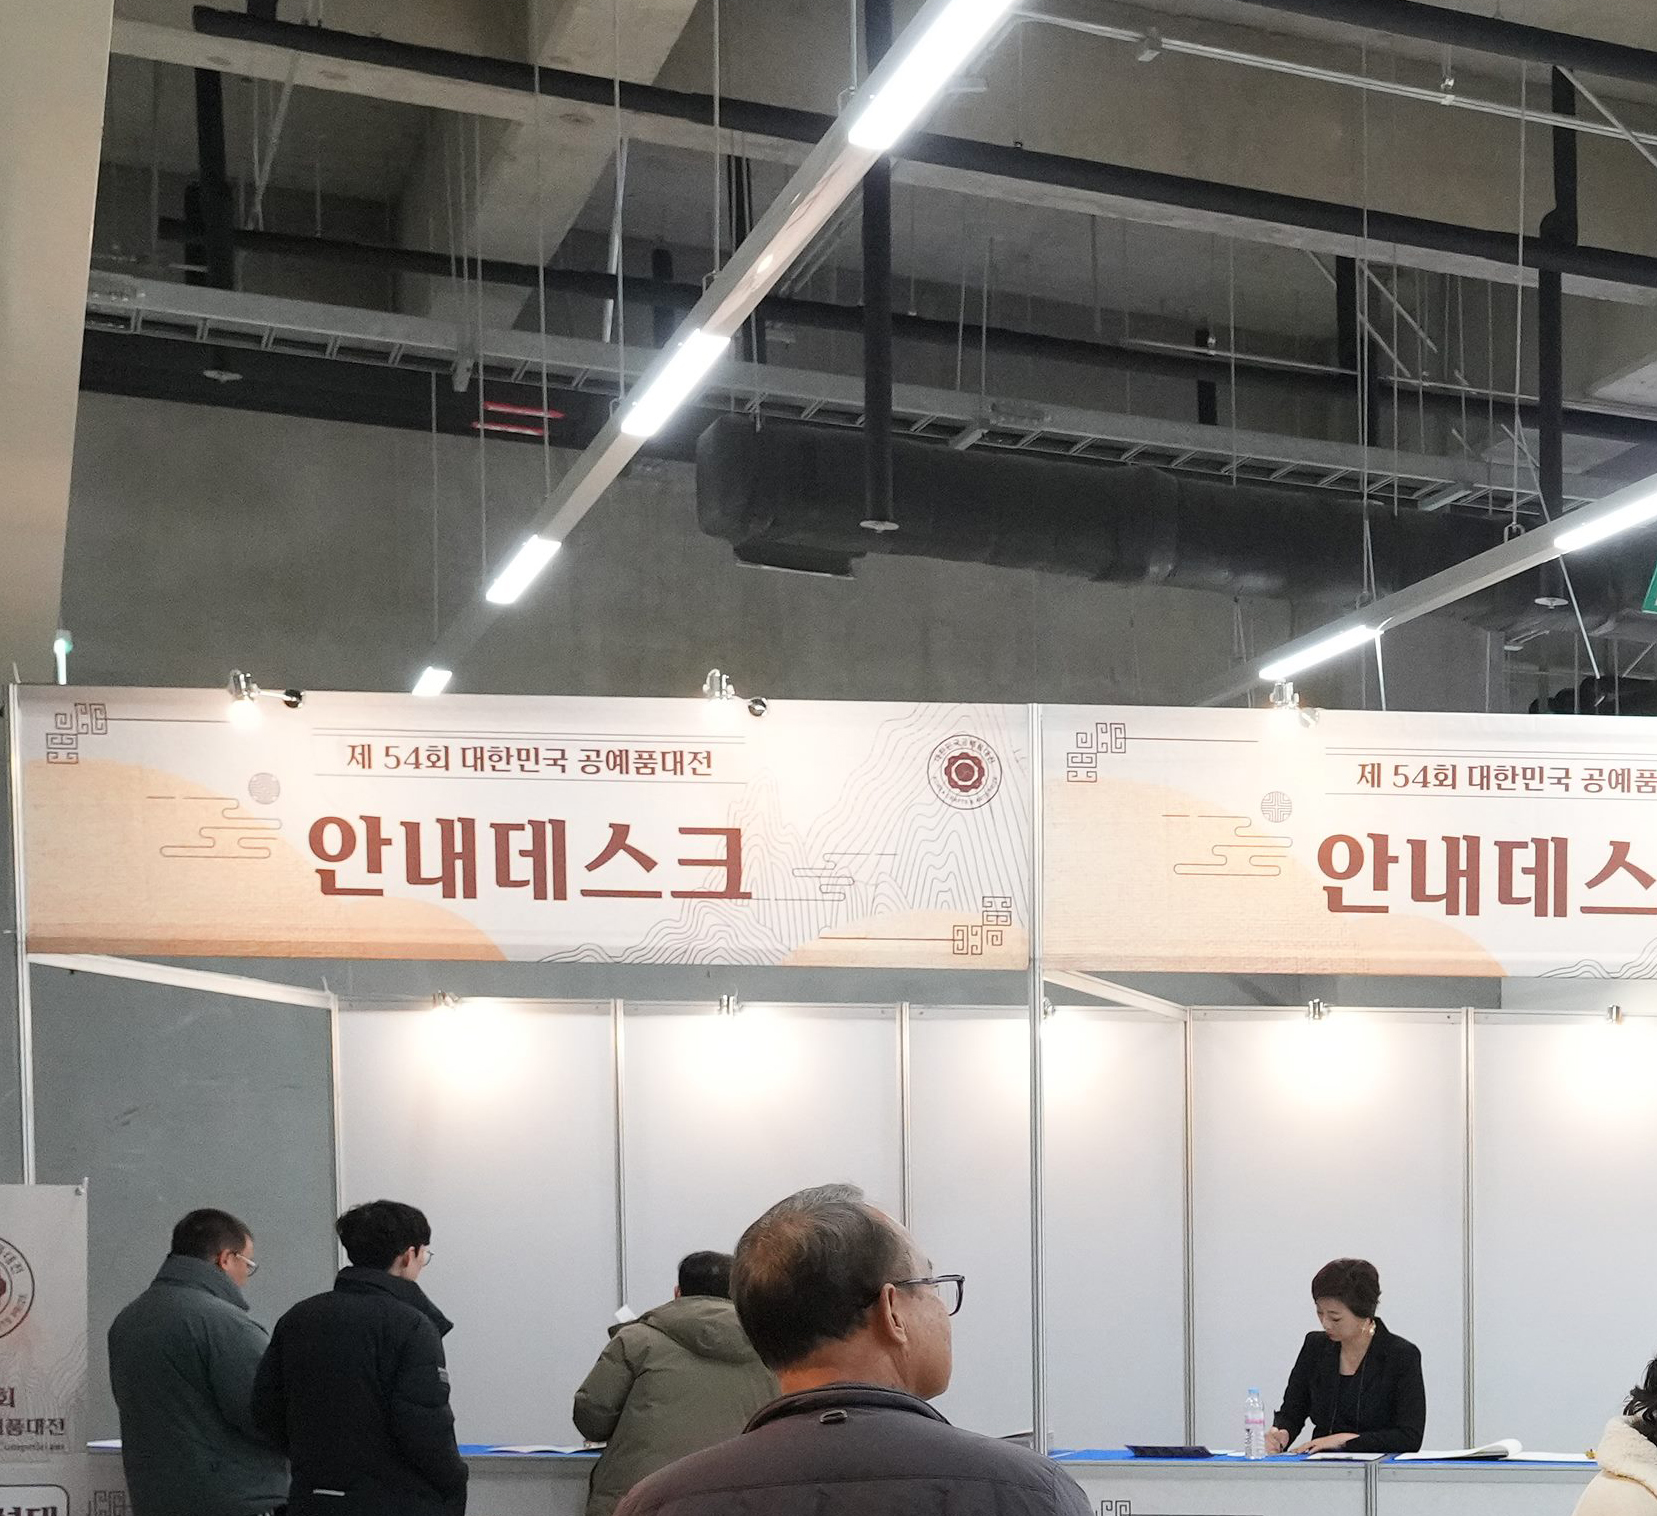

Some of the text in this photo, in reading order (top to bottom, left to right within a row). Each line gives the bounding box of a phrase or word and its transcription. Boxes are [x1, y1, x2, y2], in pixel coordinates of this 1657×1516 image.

[346, 744, 713, 779] 제 54회 대한민국 공예품대전
[1356, 763, 1383, 790] 제
[1392, 764, 1458, 791] 54회
[1467, 763, 1572, 794] 대한민국
[307, 813, 753, 902] 안내데스크
[0, 1417, 65, 1437] 품대전
